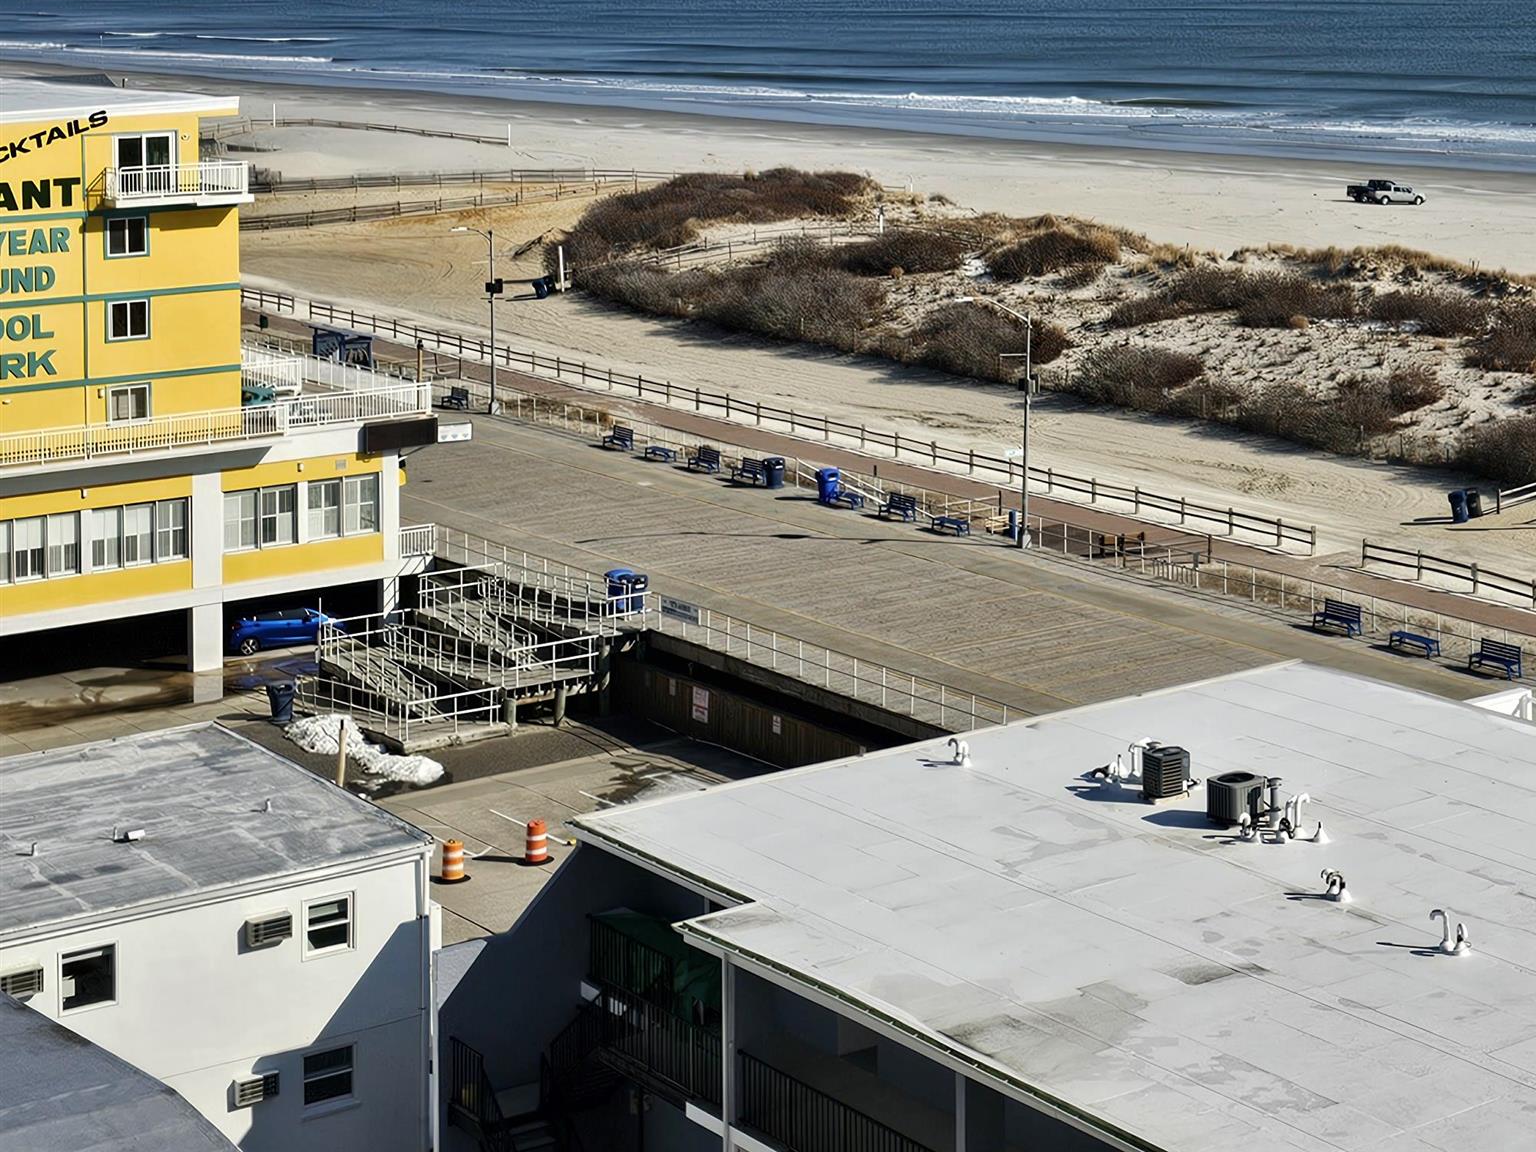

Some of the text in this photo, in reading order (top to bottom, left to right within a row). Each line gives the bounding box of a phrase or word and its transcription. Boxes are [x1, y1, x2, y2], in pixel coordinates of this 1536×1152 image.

[0, 177, 81, 211] ANT
[0, 314, 55, 341] OL
[0, 350, 57, 380] RK
